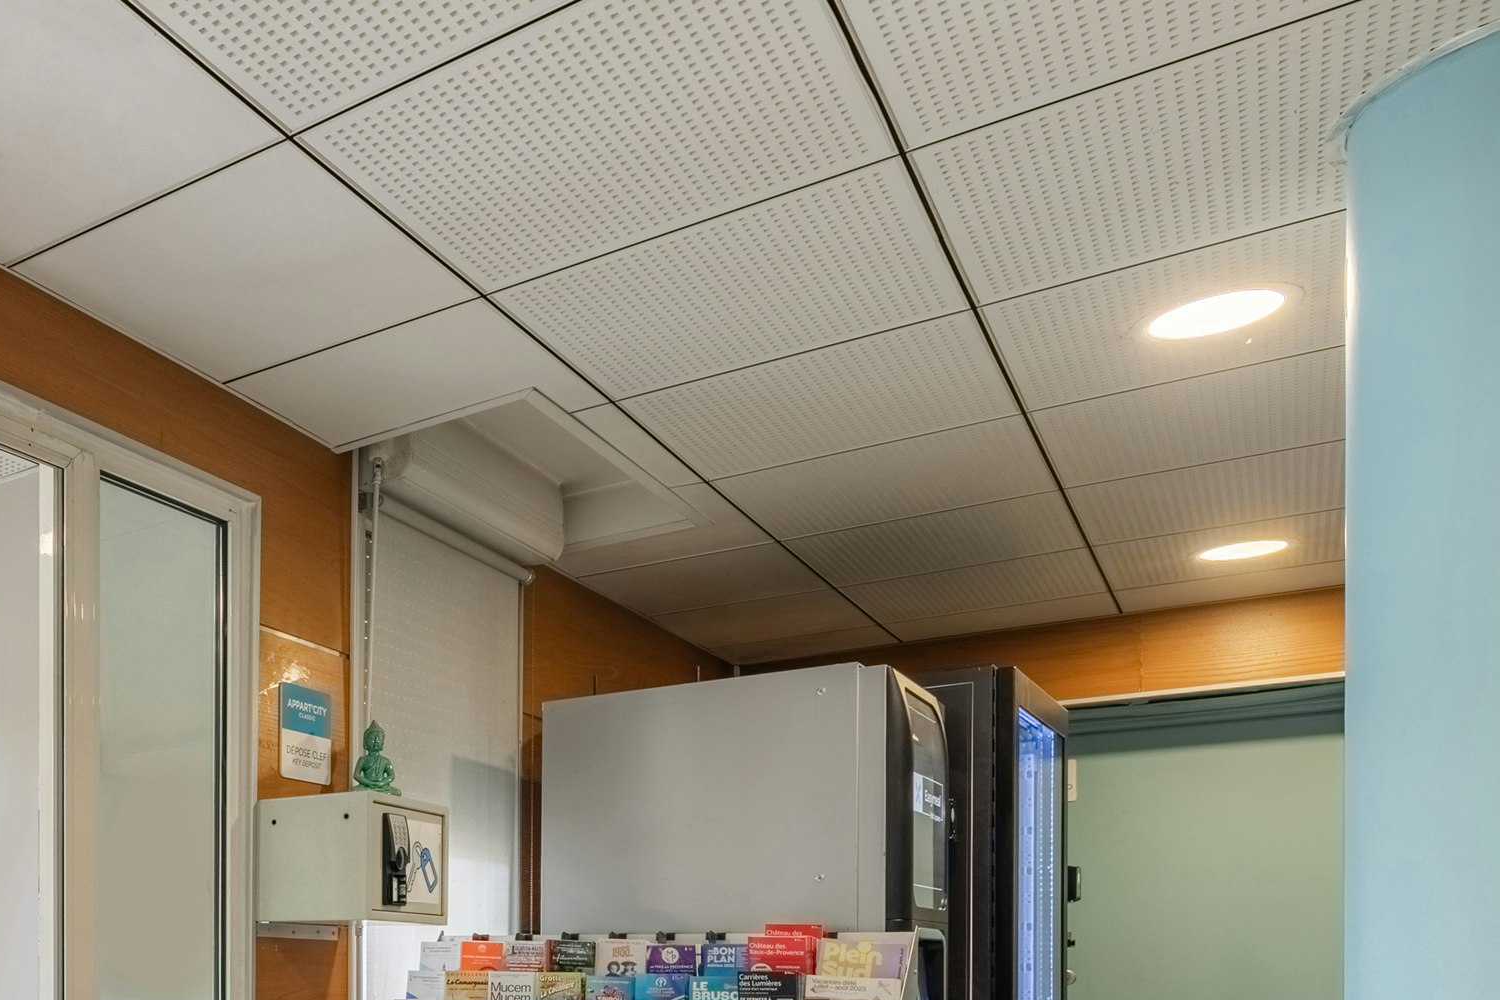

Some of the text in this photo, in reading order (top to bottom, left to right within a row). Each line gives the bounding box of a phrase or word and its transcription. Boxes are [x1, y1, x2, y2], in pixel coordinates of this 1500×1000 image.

[299, 712, 316, 722] CLASSIC
[286, 745, 328, 761] DÉPOSE CLEF
[292, 759, 321, 769] KEY DEPOSIT
[713, 947, 736, 955] BON
[822, 941, 883, 966] Plein
[707, 955, 736, 963] PLAN
[821, 959, 872, 978] Sud
[490, 982, 531, 993] Mucem
[693, 981, 708, 991] LE
[692, 991, 738, 1000] BRUSC
